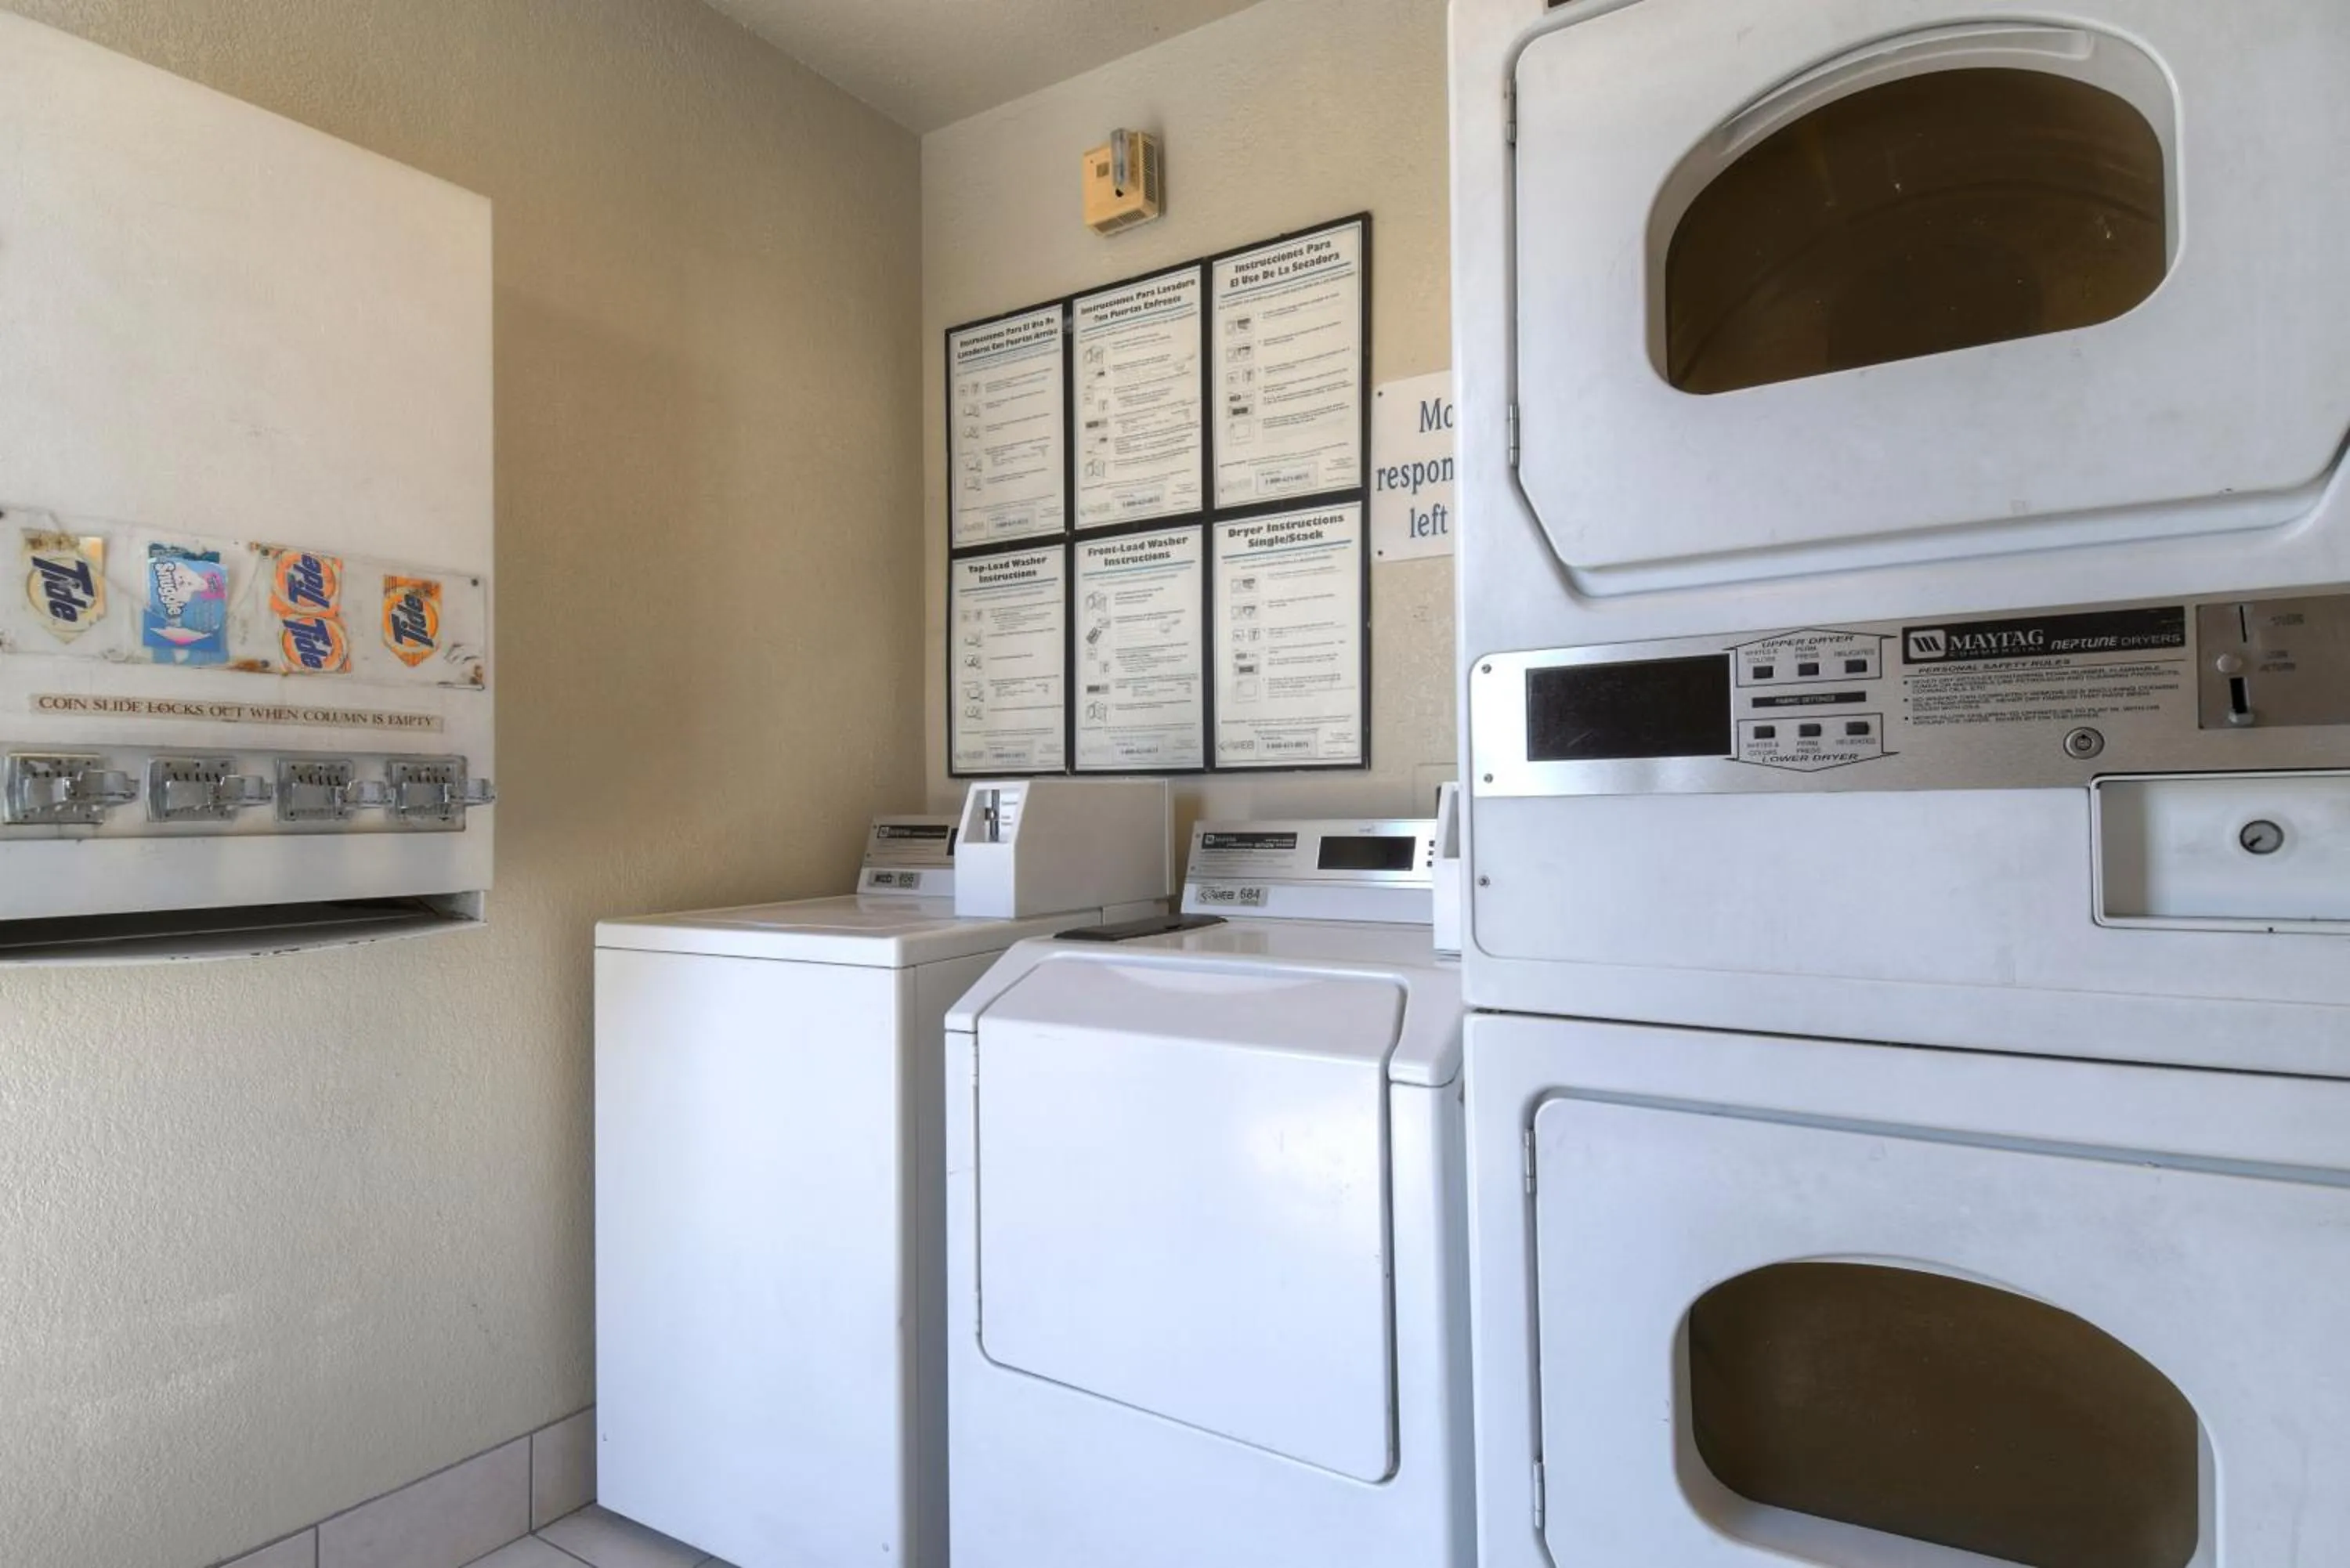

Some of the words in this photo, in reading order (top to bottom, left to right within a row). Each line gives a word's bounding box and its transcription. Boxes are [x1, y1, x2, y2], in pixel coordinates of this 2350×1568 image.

[1306, 240, 1331, 254] Para
[1278, 266, 1290, 276] La
[1227, 525, 1263, 538] Dryer
[1266, 514, 1345, 533] Instructions
[1409, 504, 1448, 538] left
[1087, 541, 1145, 557] Front-Load
[1147, 536, 1188, 549] Washer
[1248, 529, 1324, 548] Single/Stack
[1011, 556, 1047, 568] Washer
[1104, 551, 1171, 566] Instructions
[287, 553, 330, 609] Tide
[979, 569, 1038, 583] Instructions
[32, 557, 98, 623] Tide
[154, 561, 187, 616] Snuggle
[391, 594, 434, 647] Tide
[283, 617, 332, 669] Tide
[1762, 638, 1805, 649] UPPER
[1809, 635, 1855, 645] DRYER
[1949, 629, 2044, 651] MAYTAG
[2121, 634, 2182, 646] DRYERS
[38, 695, 87, 710] COIN
[92, 698, 143, 714] SLIDE
[147, 701, 204, 716] LOCKS
[250, 706, 298, 721] WHEN
[303, 710, 367, 724] COLUMN
[372, 713, 383, 724] IS
[389, 714, 432, 727] EMPTY
[1762, 753, 1809, 763] LOWER
[1812, 753, 1859, 761] DRYER
